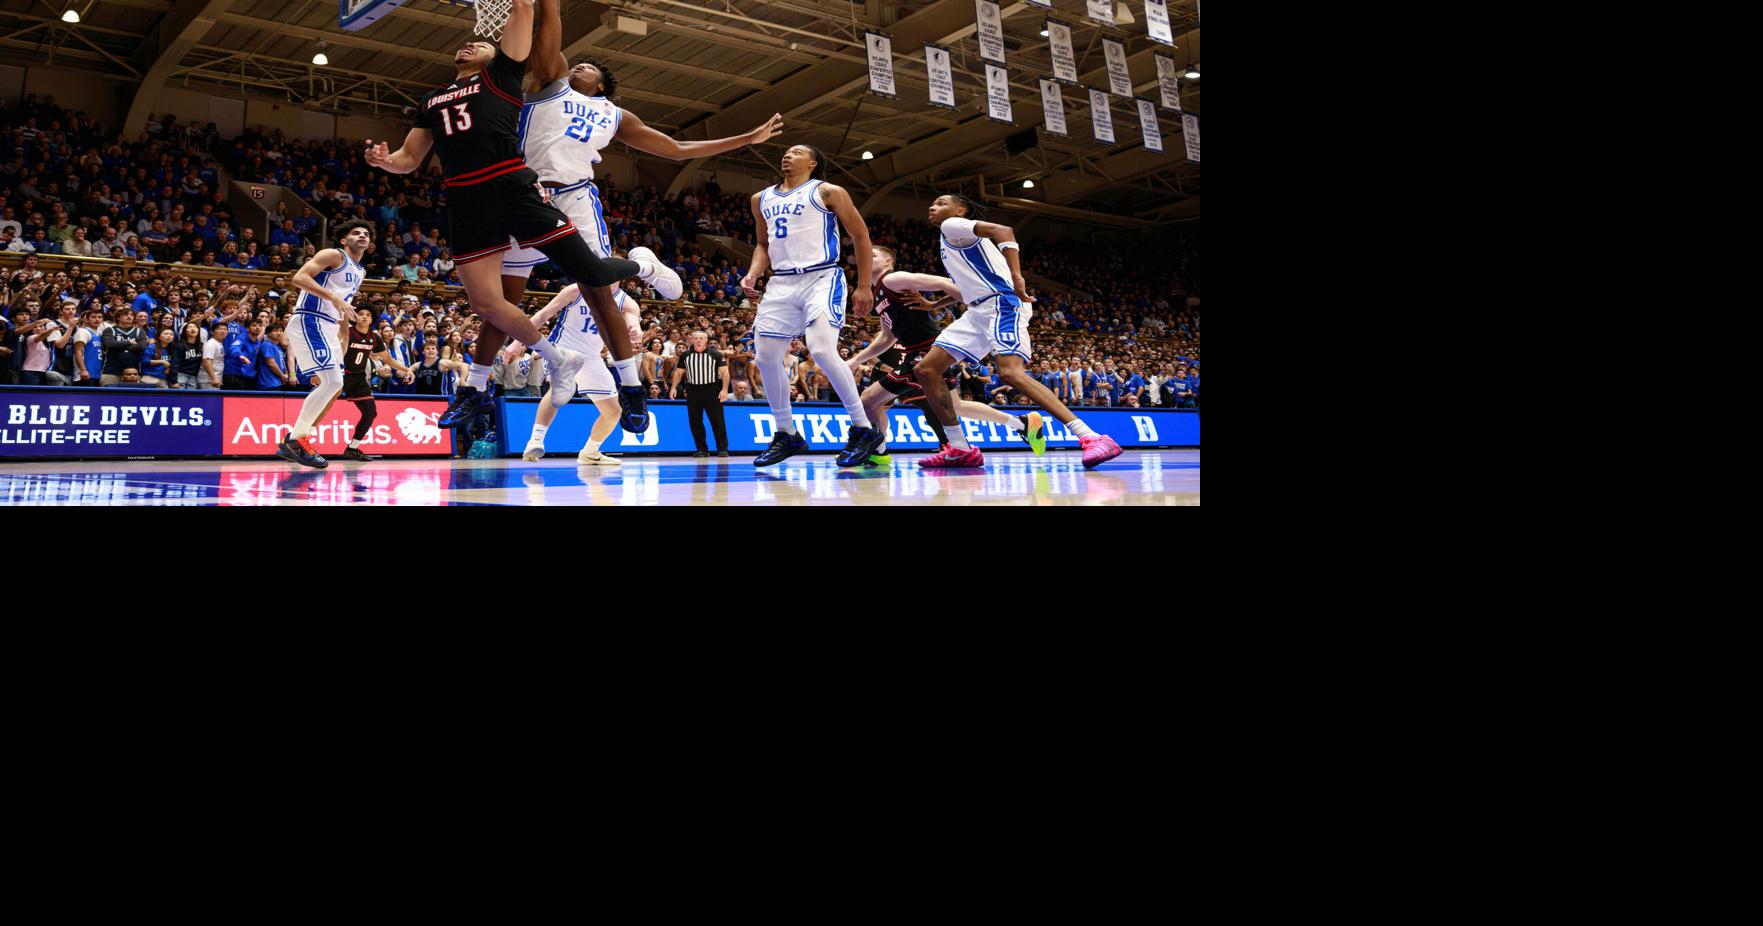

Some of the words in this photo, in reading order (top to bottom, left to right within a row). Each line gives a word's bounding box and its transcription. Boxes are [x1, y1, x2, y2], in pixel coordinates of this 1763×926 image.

[427, 83, 481, 109] LOUISVILLE
[440, 102, 472, 135] 13
[563, 100, 611, 129] DUKE
[564, 116, 593, 143] 21
[253, 190, 264, 198] 15
[764, 203, 805, 219] DUKE
[775, 217, 788, 239] 6
[581, 316, 599, 335] 14
[355, 352, 364, 365] 0
[8, 404, 91, 424] BLUE
[0, 429, 131, 444] LLITE-FREE
